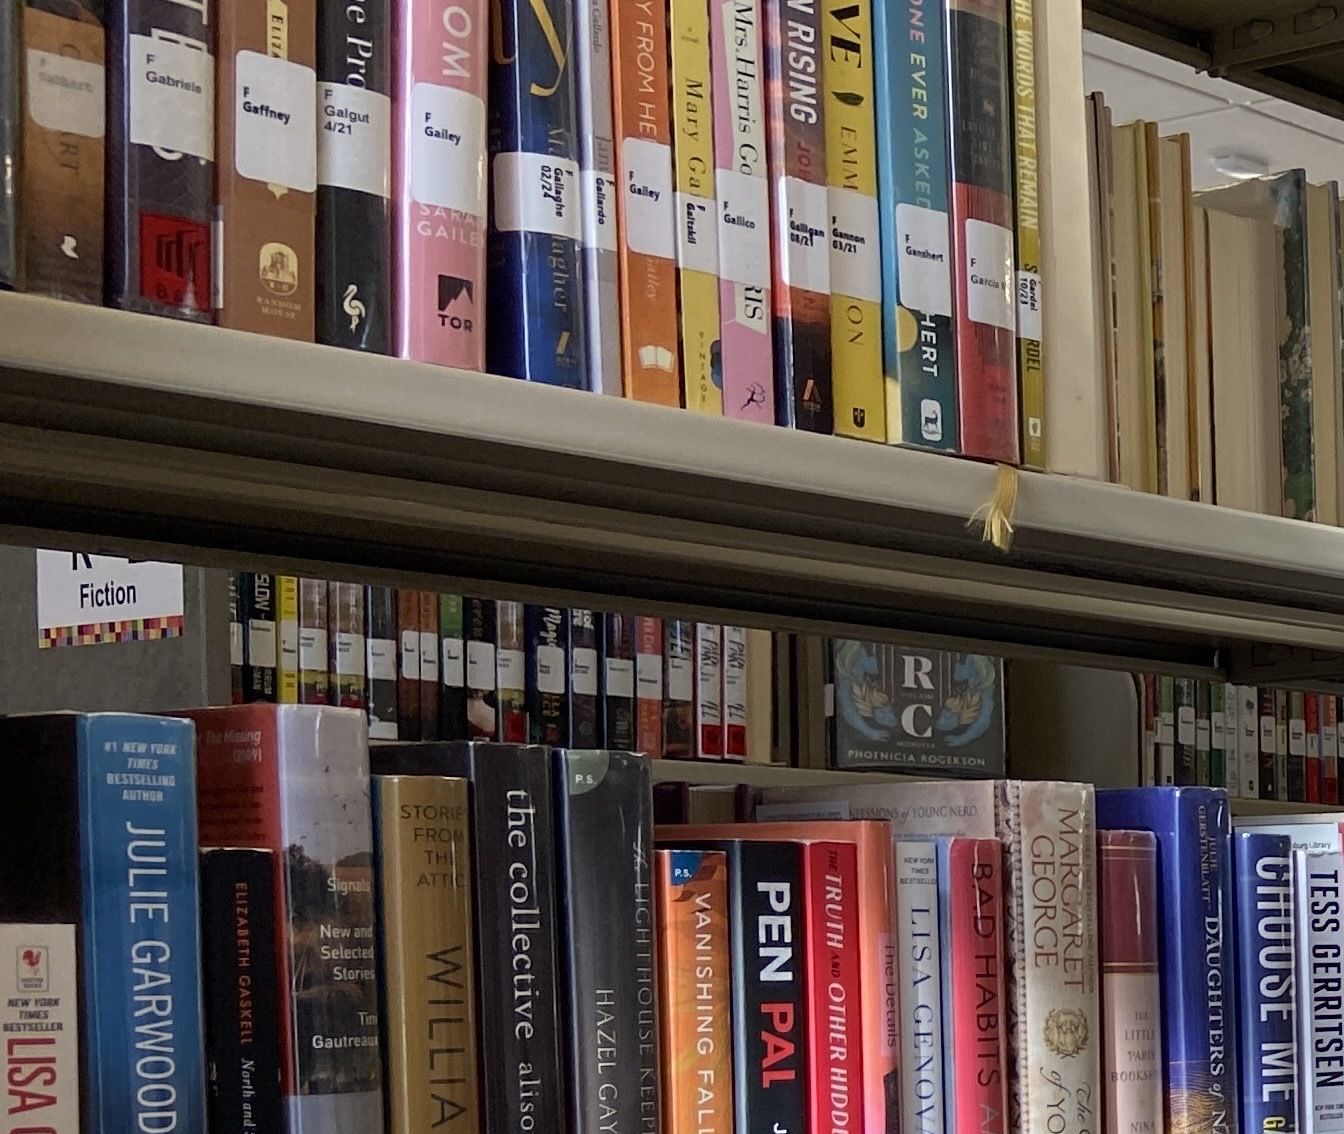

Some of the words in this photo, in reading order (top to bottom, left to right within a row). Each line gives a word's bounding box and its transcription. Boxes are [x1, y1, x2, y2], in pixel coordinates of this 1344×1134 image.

[636, 21, 655, 93] FROM
[787, 21, 818, 125] RISING
[910, 53, 928, 120] EVER
[1014, 29, 1035, 98] WORDS
[243, 101, 291, 124] Gaffney
[324, 105, 370, 124] Galgut
[683, 78, 704, 141] Mary
[734, 54, 756, 134] Harris
[324, 122, 353, 136] 4/21
[424, 126, 462, 145] Gailey
[1016, 104, 1037, 156] THAT
[629, 184, 661, 201] Gailey
[1018, 156, 1039, 229] REMAIN
[905, 245, 944, 262] Ganshert
[438, 315, 473, 333] TOR
[80, 581, 138, 608] Fiction
[902, 655, 935, 690] R
[123, 742, 146, 754] NEW
[901, 703, 933, 738] C
[107, 774, 175, 787] BESTSELLING
[127, 758, 158, 770] TIMES
[848, 749, 917, 764] PHOENICIA
[920, 754, 985, 767] ROGERSON
[122, 790, 164, 802] AUTHOR
[506, 788, 537, 849] the
[125, 821, 169, 924] JULIE
[327, 877, 372, 894] Signals
[972, 862, 996, 940] BAD
[1031, 834, 1060, 969] GEORGE
[1058, 808, 1086, 995] MARGARET
[1309, 869, 1340, 933] TESS
[235, 882, 251, 968] ELIZABETH
[320, 924, 347, 938] New
[756, 881, 793, 983] PEN
[825, 873, 845, 949] TRUTH
[1255, 856, 1297, 1023] CHOOSE
[320, 945, 374, 961] Selected
[333, 967, 375, 982] Stories
[508, 861, 542, 1041] collective
[633, 880, 653, 1056] LIGHTHOUSE
[695, 892, 715, 1056] VANISHING
[910, 908, 933, 987] LISA
[3, 1022, 63, 1032] BESTSELLER
[237, 975, 254, 1046] GASKELL
[828, 982, 848, 1063] OTHER
[974, 954, 999, 1088] HABITS
[1204, 915, 1227, 1077] DAUGHTERS
[1312, 943, 1344, 1089] GERRITSEN
[130, 940, 177, 1134] GARWOOD
[594, 988, 617, 1074] HAZEL
[760, 1003, 796, 1089] PAL
[7, 1037, 58, 1115] LISA
